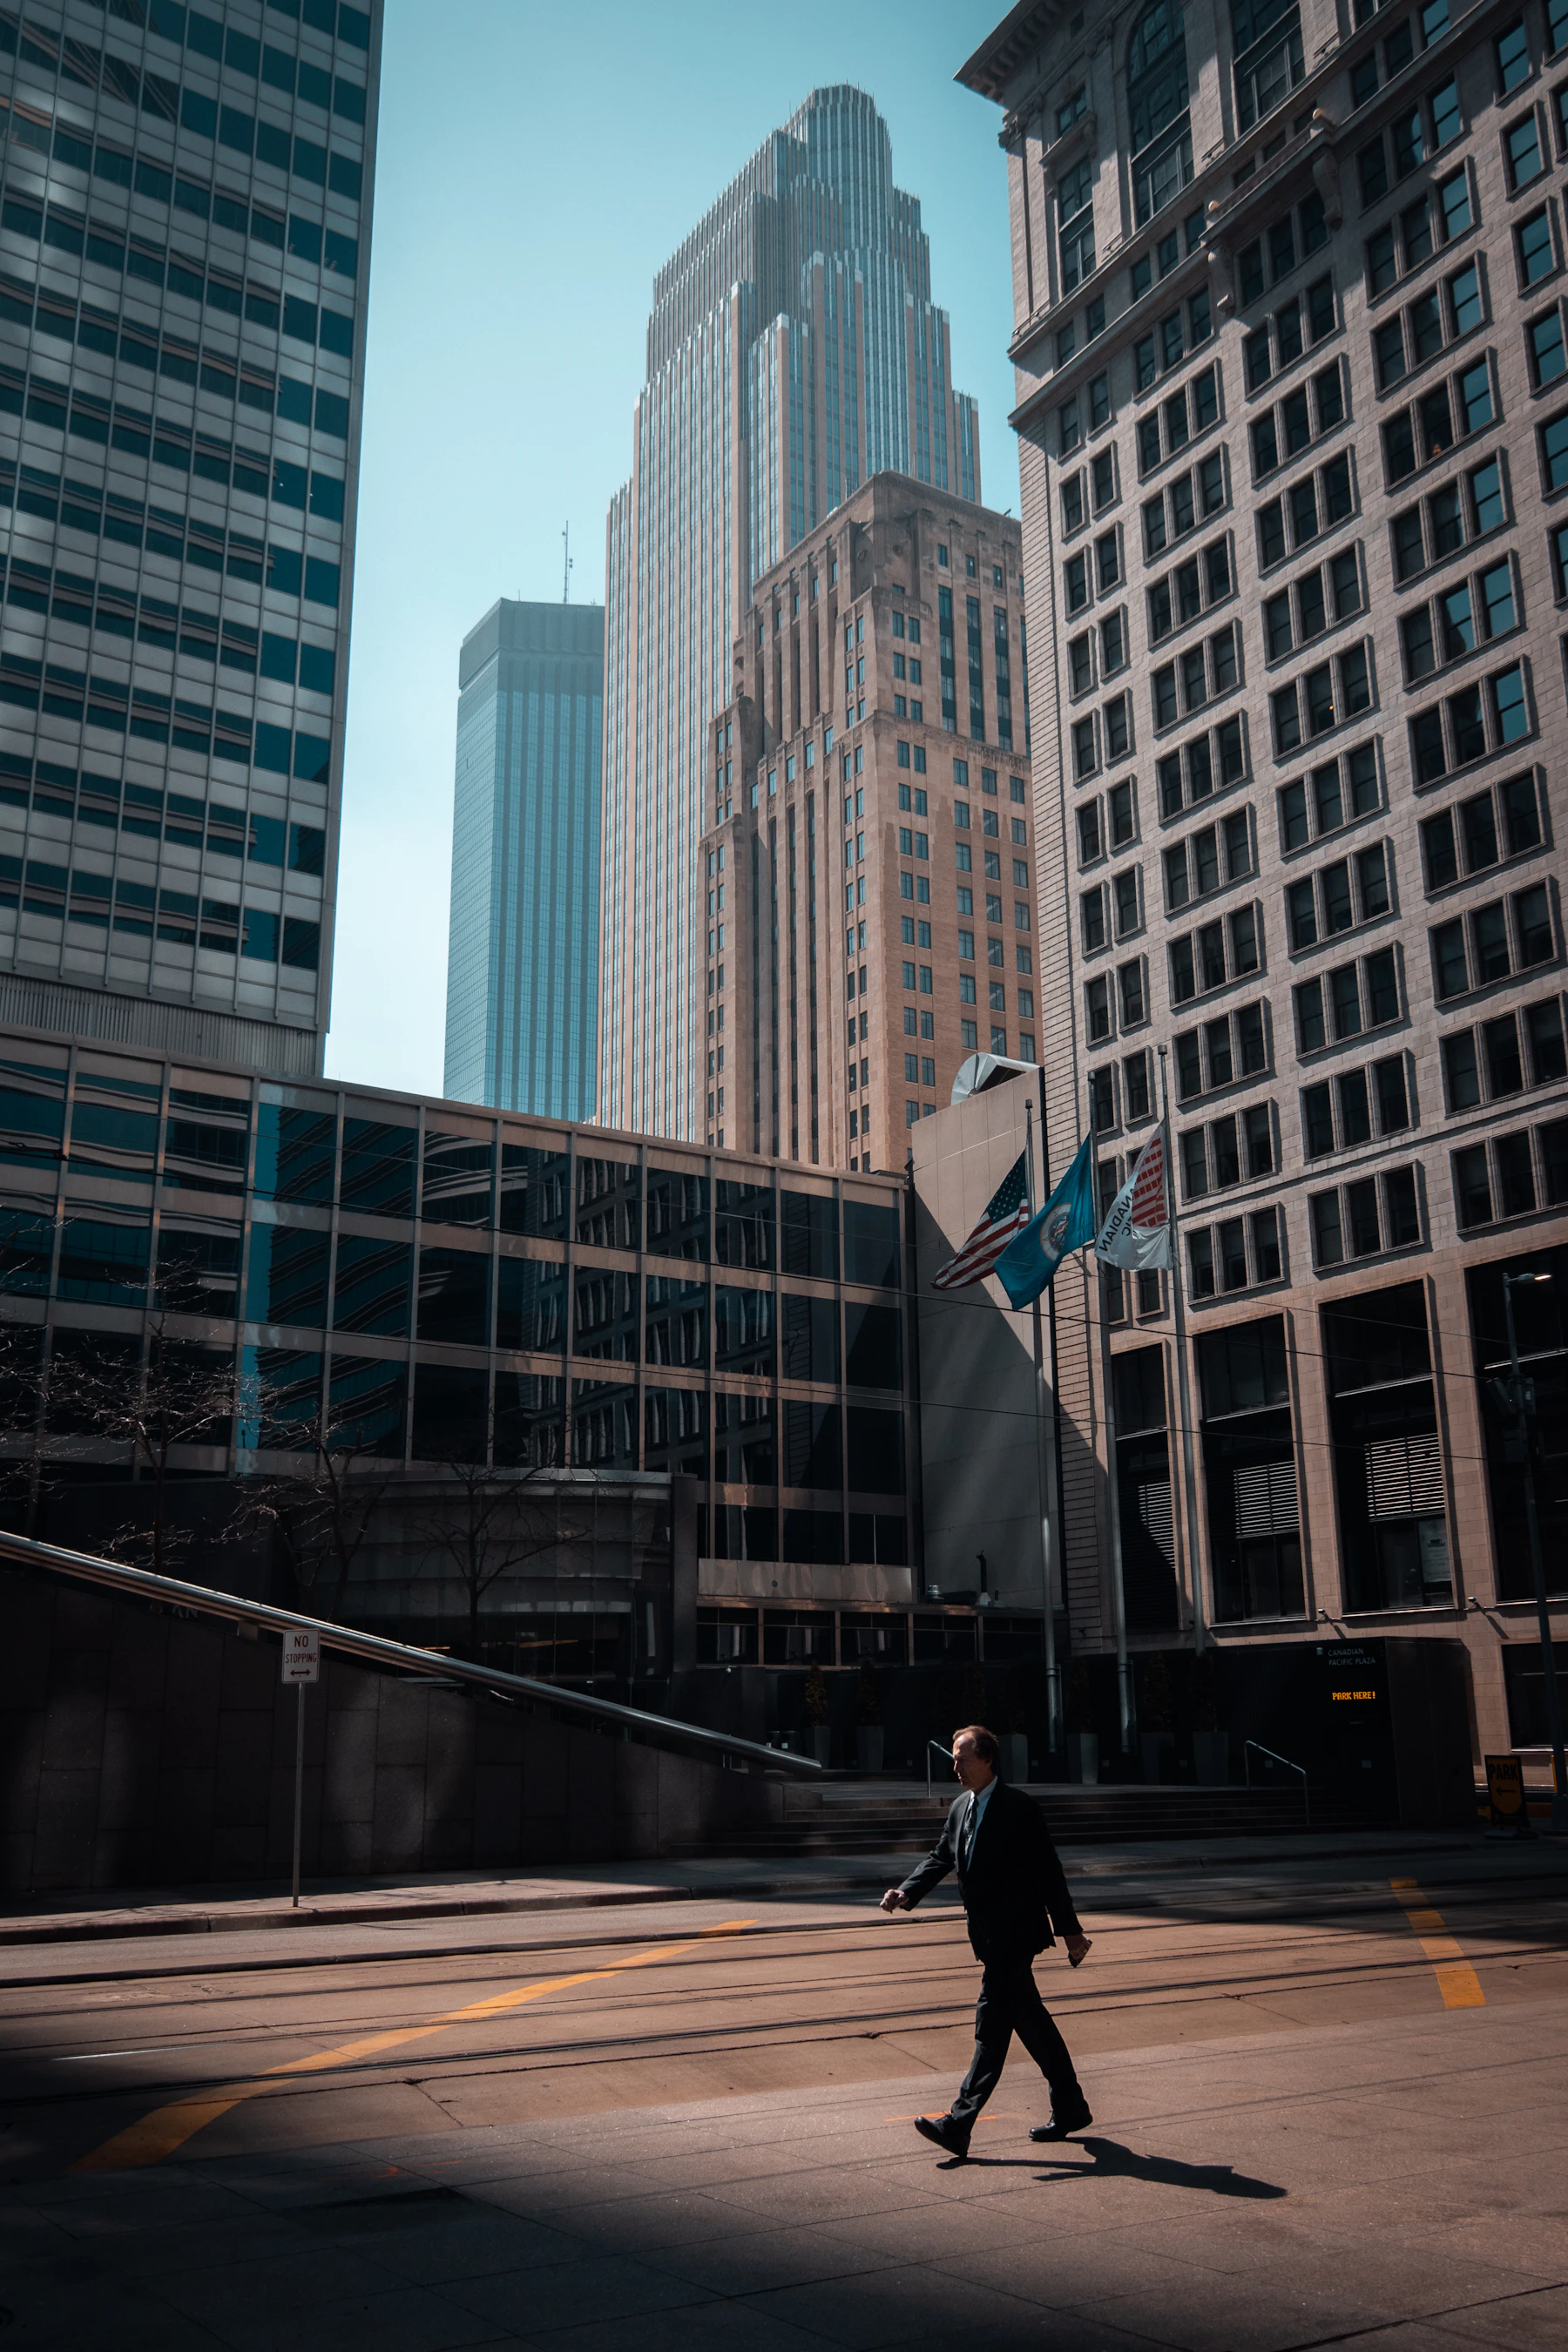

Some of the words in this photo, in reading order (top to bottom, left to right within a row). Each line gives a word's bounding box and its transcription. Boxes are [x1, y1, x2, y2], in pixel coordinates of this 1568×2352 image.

[294, 1635, 309, 1647] NO
[1328, 1647, 1364, 1657] CANADIAN
[285, 1652, 317, 1664] STOPPING
[1328, 1658, 1354, 1666] PACIFIC
[1355, 1656, 1376, 1665] PLAZA
[1332, 1692, 1352, 1700] PARK
[1353, 1691, 1376, 1700] HERE!
[1488, 1763, 1518, 1780] PARK
